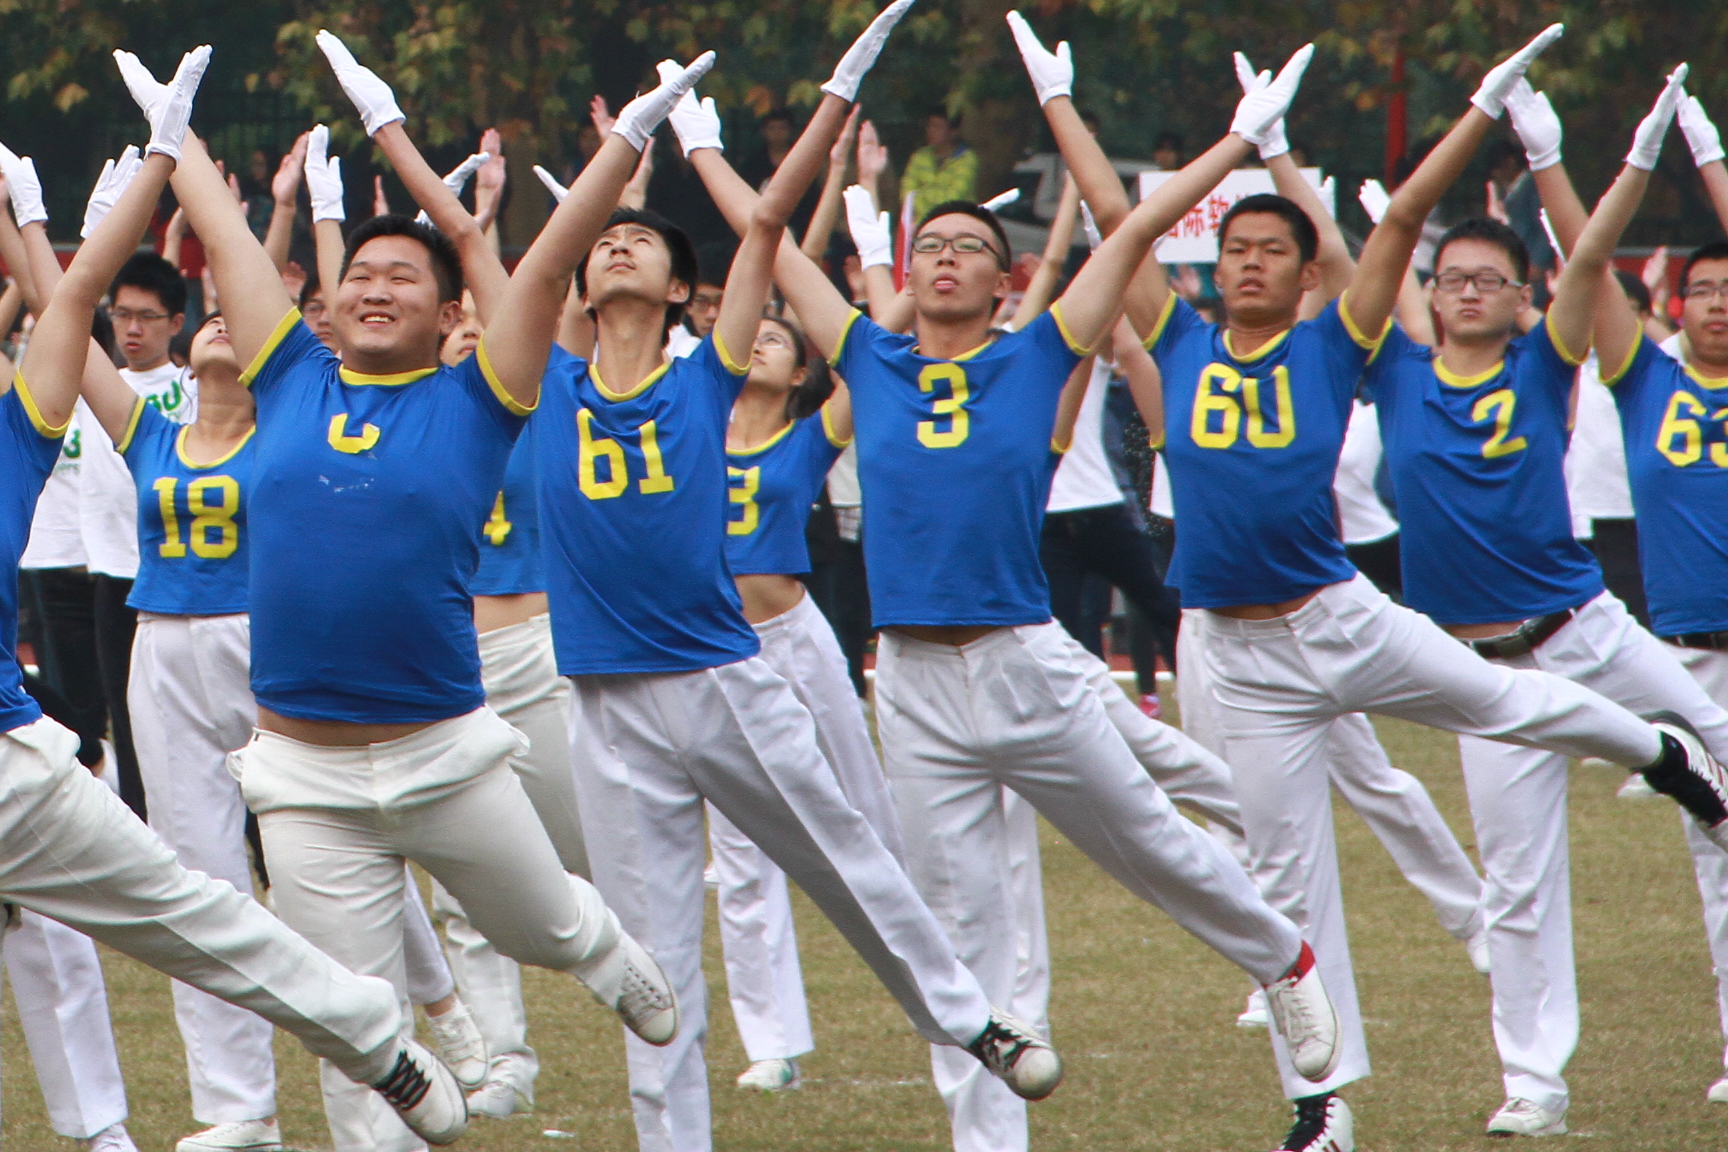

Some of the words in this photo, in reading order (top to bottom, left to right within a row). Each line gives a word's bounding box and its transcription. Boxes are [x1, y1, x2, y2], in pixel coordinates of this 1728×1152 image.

[917, 362, 970, 448] 3
[1191, 362, 1296, 449] 60
[1472, 389, 1527, 458] 2
[576, 408, 675, 500] 61
[153, 475, 239, 558] 18
